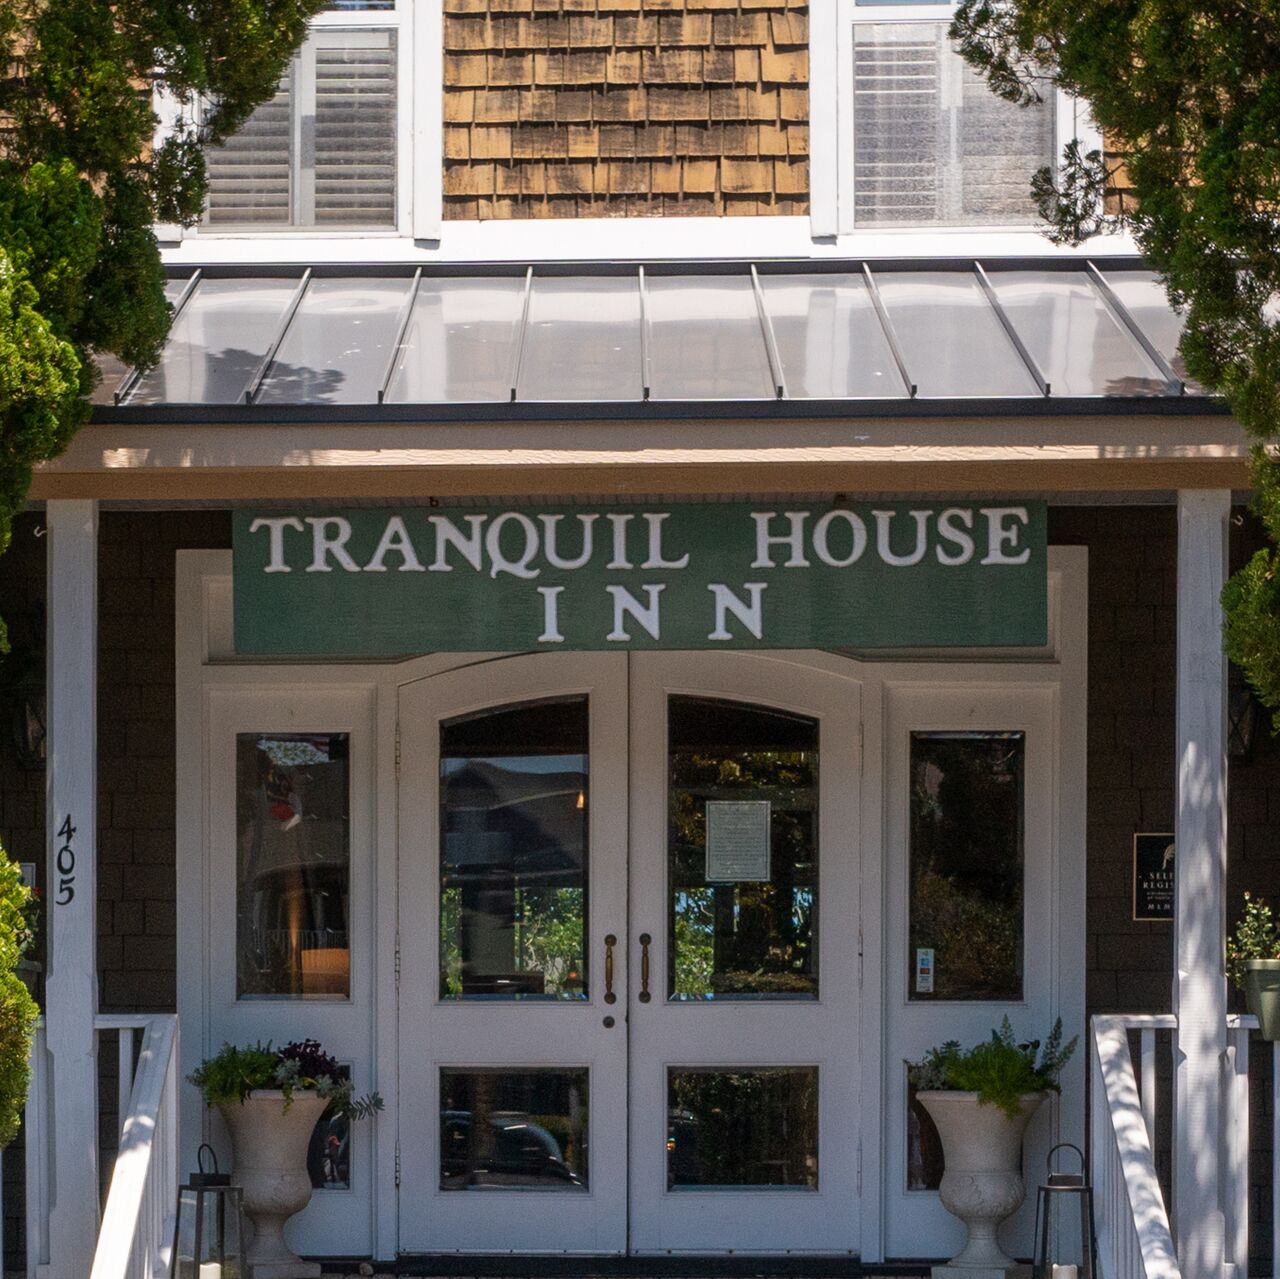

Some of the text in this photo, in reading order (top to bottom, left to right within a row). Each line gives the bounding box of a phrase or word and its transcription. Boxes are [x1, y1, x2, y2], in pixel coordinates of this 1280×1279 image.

[248, 505, 1032, 580] TRANQUIL HOUSE
[536, 582, 768, 643] INN
[56, 813, 77, 906] 405
